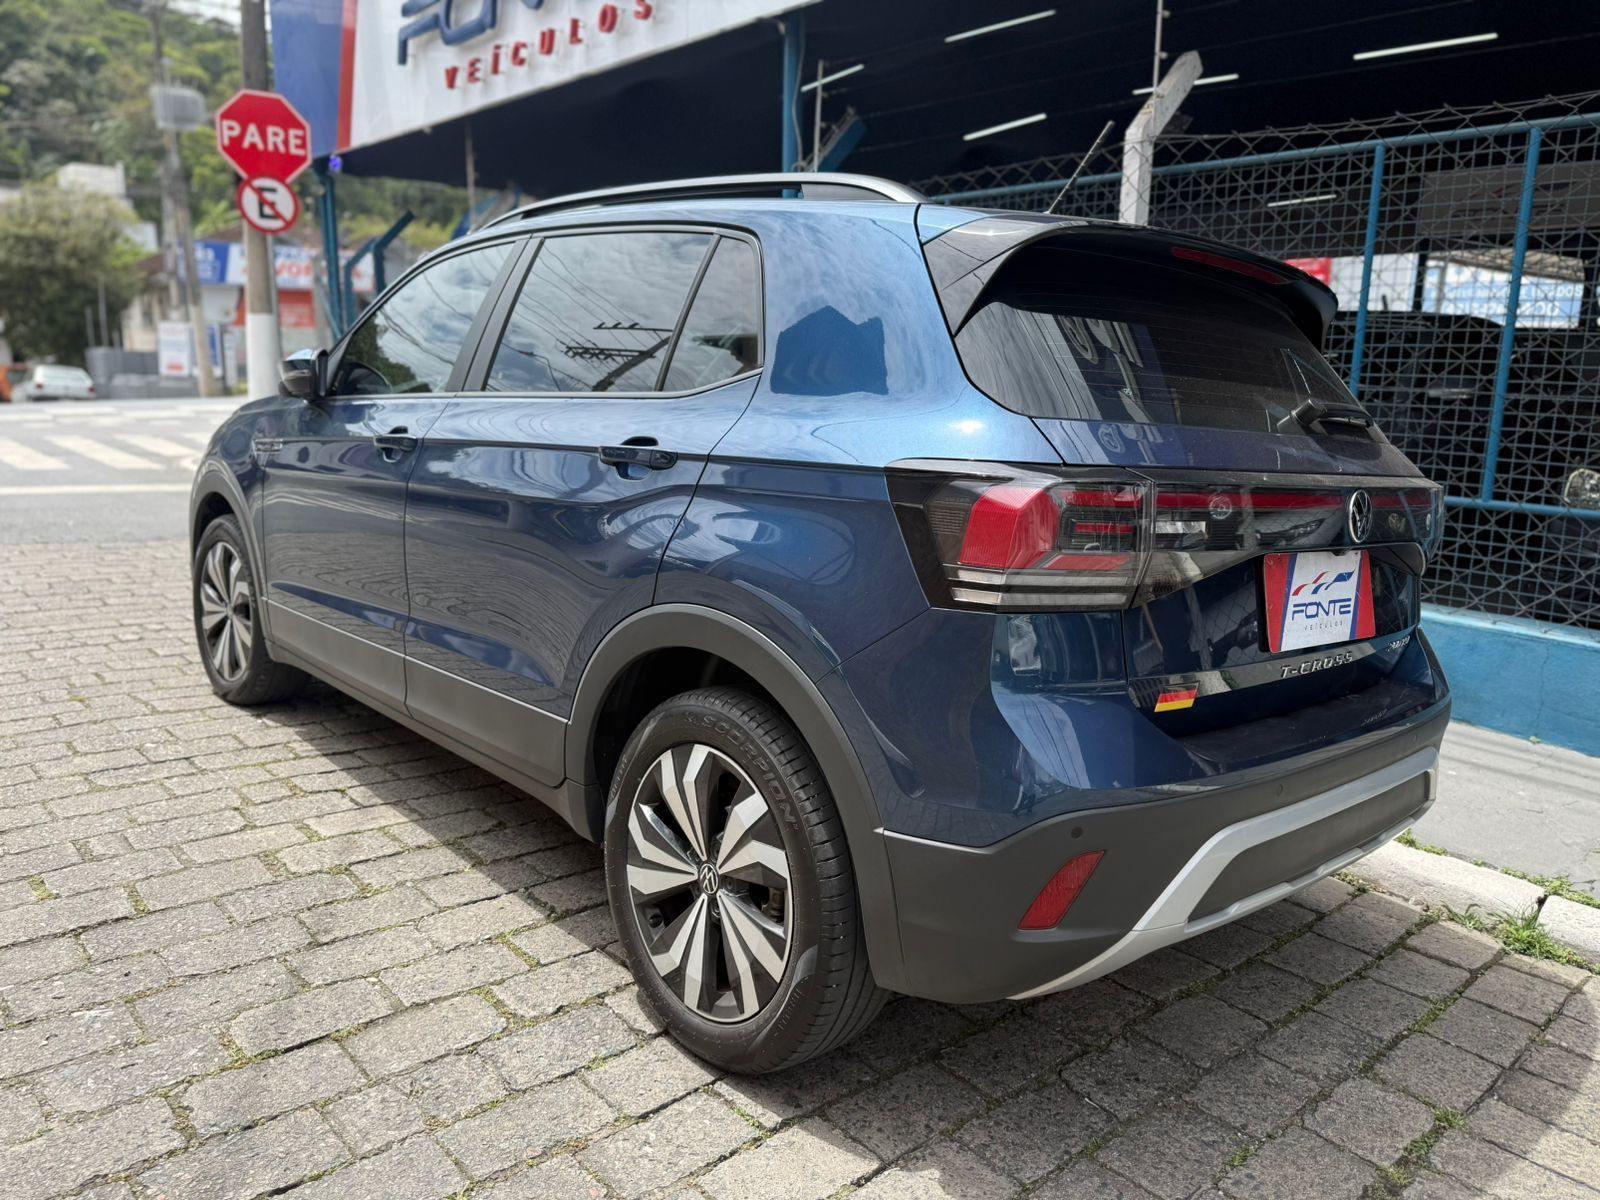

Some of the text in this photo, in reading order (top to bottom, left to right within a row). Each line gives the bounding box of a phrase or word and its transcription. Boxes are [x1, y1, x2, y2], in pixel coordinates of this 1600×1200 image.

[221, 119, 306, 156] PARE
[1291, 597, 1352, 621] FONTE
[1281, 651, 1353, 679] T-CROSS
